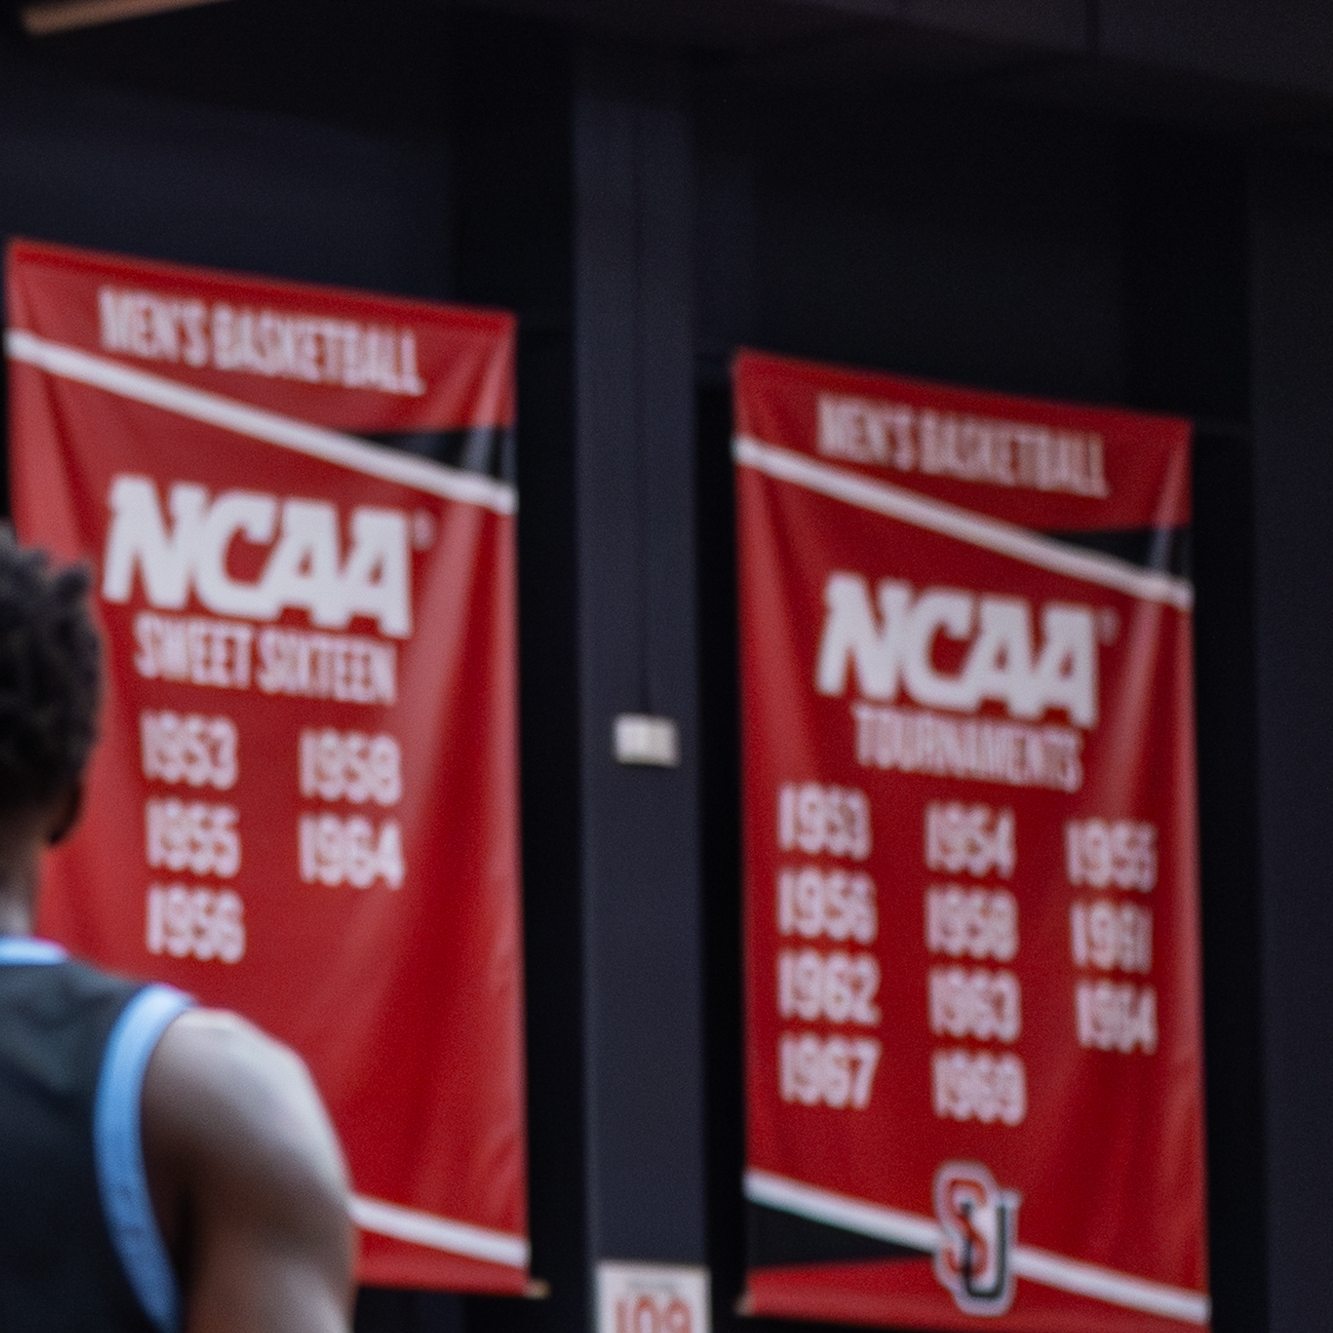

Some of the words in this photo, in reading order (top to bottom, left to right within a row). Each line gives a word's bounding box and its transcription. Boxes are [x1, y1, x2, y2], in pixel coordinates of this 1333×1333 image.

[99, 287, 208, 367] MEN'S
[210, 304, 424, 396] BASKETBALL
[817, 393, 914, 472] MEN'S
[916, 405, 1108, 499] BASKETBALL
[103, 474, 412, 638] NCAA
[134, 612, 253, 690] SWEET
[255, 626, 397, 703] SIXTEEN
[817, 573, 1096, 727] NCAA
[141, 710, 237, 790] 1953
[299, 728, 405, 808] 1958
[145, 798, 241, 878] 1955
[298, 812, 406, 891] 1964
[145, 884, 246, 964] 1956
